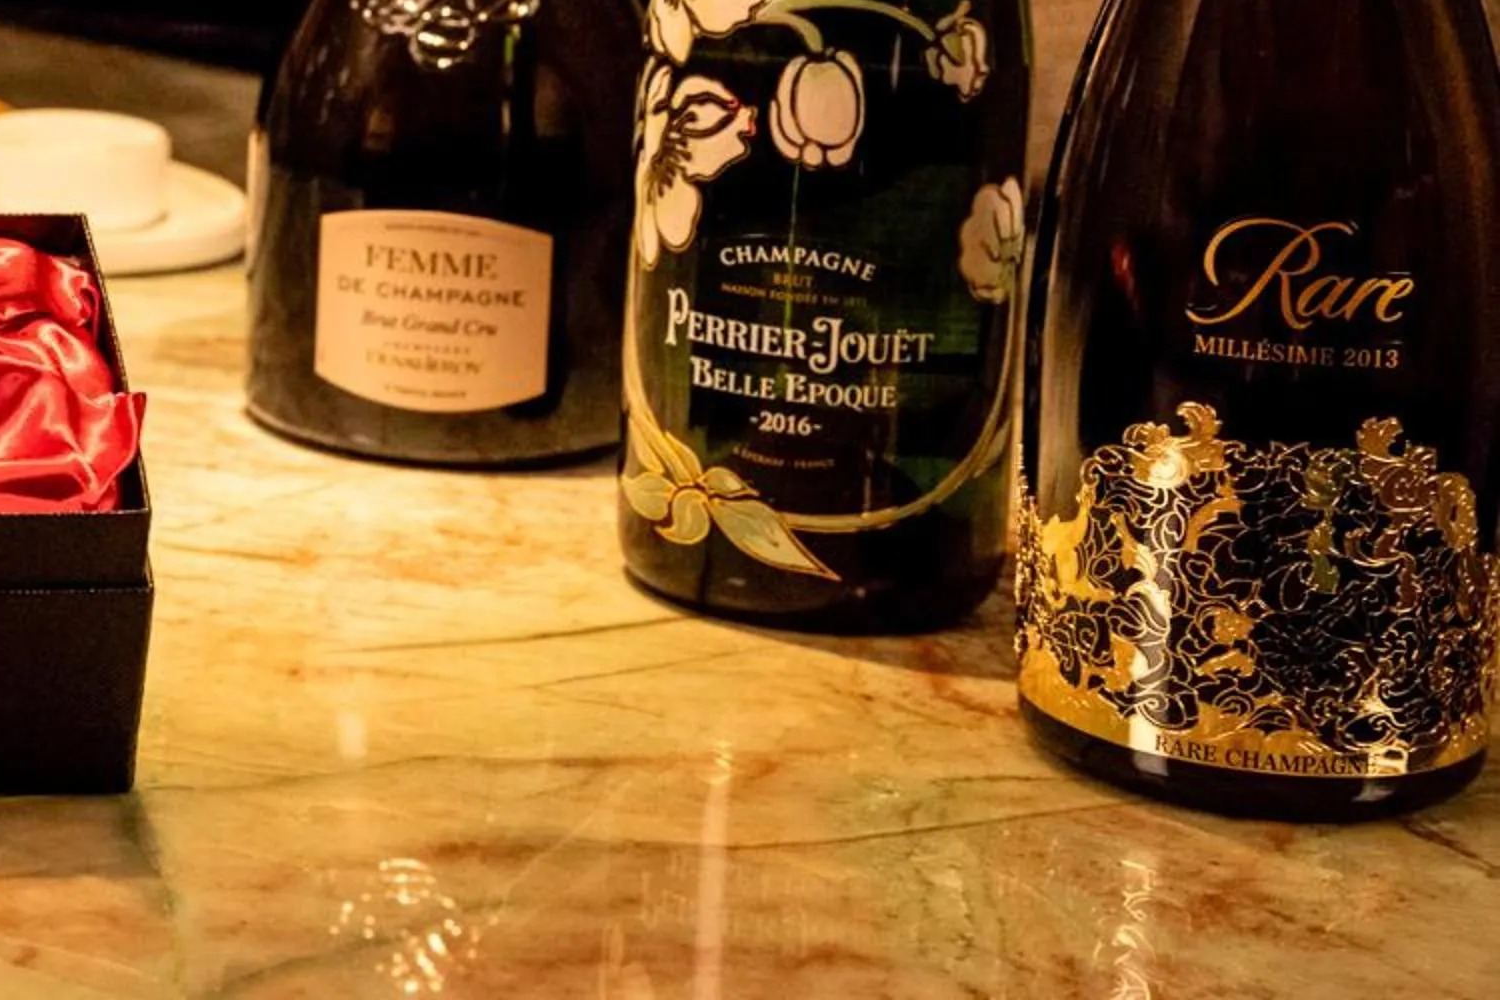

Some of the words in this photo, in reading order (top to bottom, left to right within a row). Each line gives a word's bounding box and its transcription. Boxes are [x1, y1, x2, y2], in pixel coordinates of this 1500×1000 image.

[365, 244, 498, 280] FEMME
[719, 245, 877, 282] CHAMPAGNE
[1186, 217, 1415, 330] Rare
[336, 275, 364, 294] DE
[375, 281, 527, 308] CHAMPAGNE
[402, 313, 460, 336] Grand
[463, 318, 498, 337] Cru
[665, 288, 935, 375] PERRIER-JOUËT
[1194, 334, 1334, 368] MILLÉSIME
[1343, 349, 1399, 369] 2013
[690, 356, 776, 400] BELLE
[785, 373, 898, 412] EPOQUE
[1155, 734, 1217, 760] RARE
[1225, 748, 1378, 776] CHAMPAGNE
